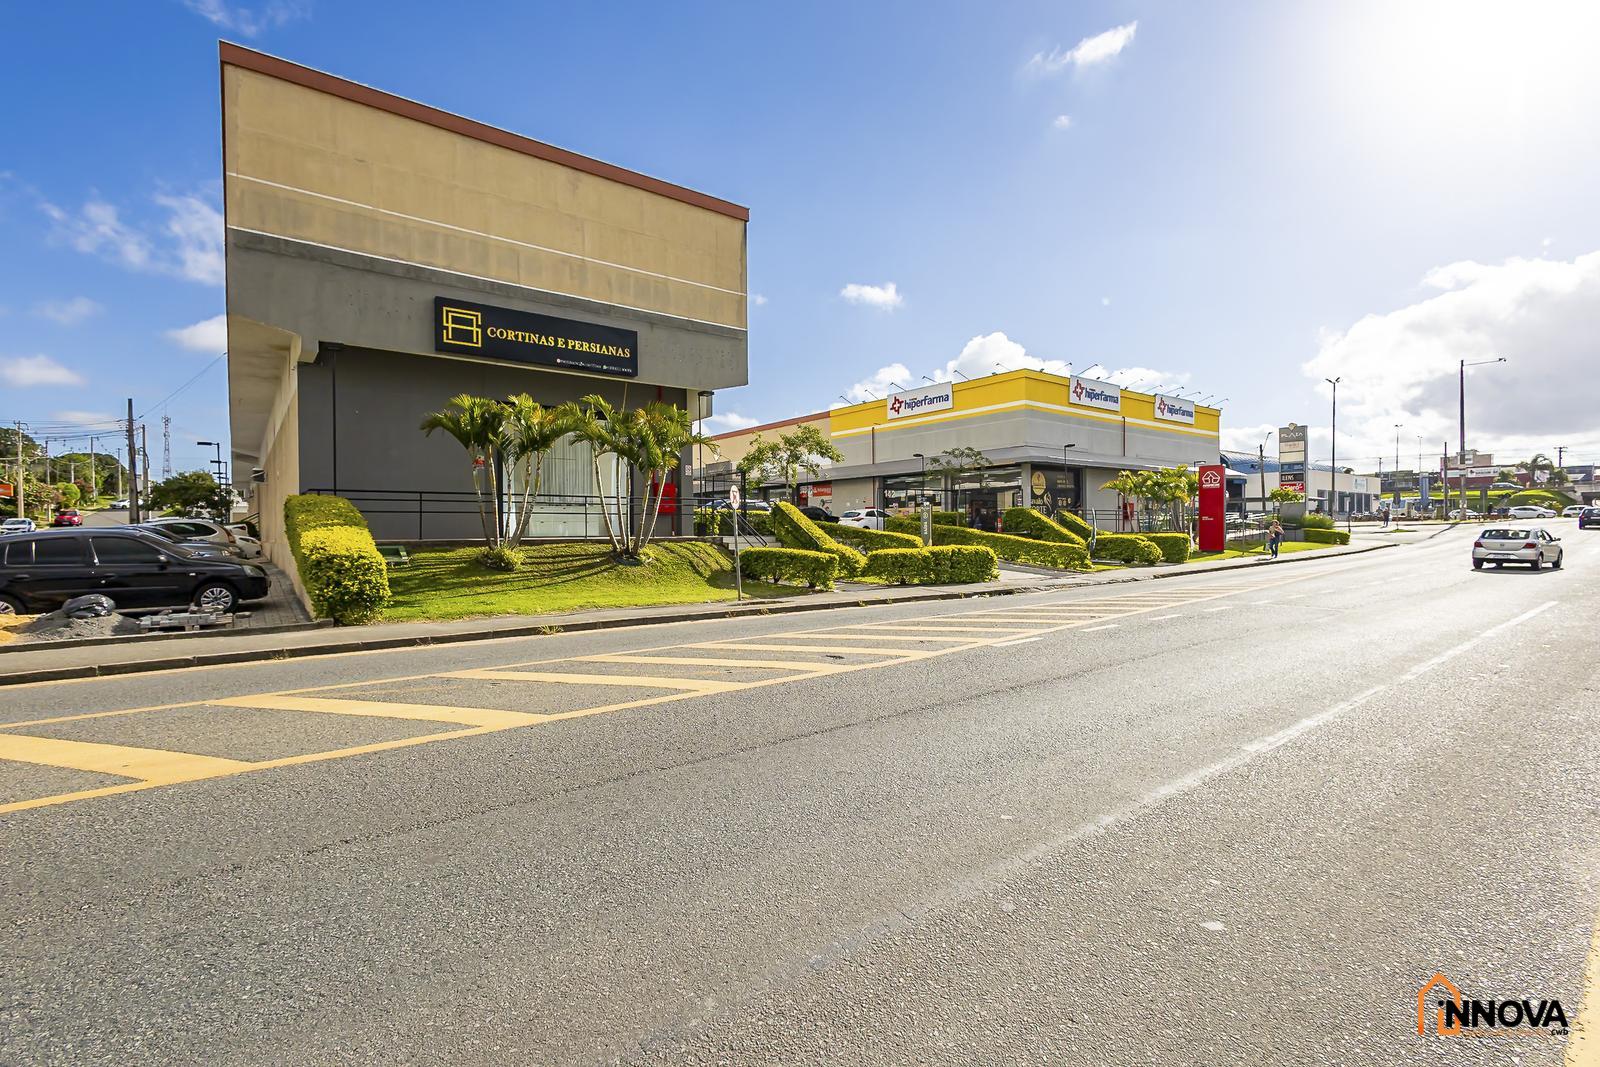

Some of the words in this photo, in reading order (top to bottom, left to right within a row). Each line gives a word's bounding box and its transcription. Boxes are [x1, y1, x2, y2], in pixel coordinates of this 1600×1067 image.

[487, 327, 554, 347] CORTINAS
[557, 337, 566, 348] E
[567, 339, 631, 358] PERSIANAS
[904, 393, 950, 411] hiperfarma
[1084, 387, 1119, 404] hiperfarma
[1166, 403, 1194, 418] hiperfarma
